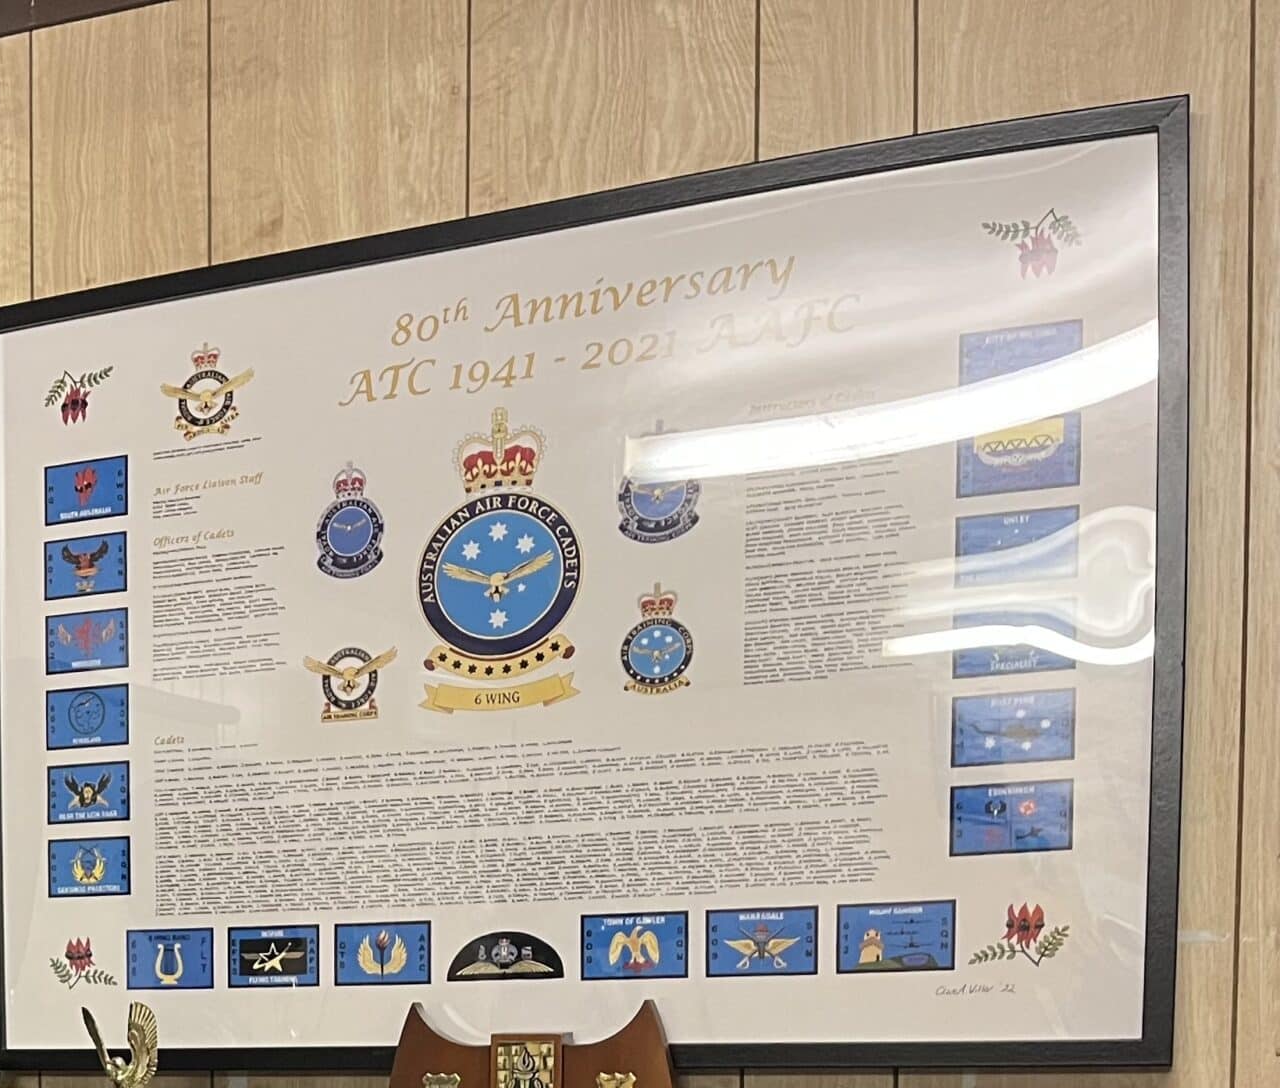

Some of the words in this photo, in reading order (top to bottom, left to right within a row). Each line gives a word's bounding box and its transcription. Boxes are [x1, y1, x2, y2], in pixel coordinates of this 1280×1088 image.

[390, 297, 470, 347] 80th
[483, 255, 795, 333] Anniversary
[338, 357, 437, 407] ATC
[448, 351, 536, 396] 1941
[581, 329, 677, 371] 2021
[697, 292, 862, 354] AAFC
[173, 482, 200, 495] Force
[153, 534, 189, 548] Officers
[203, 528, 235, 541] Cadets
[423, 510, 471, 604] AUSTRALIAN
[474, 496, 503, 515] AIR
[508, 494, 558, 526] FORCE
[555, 524, 577, 589] CADETS
[474, 693, 482, 705] 6
[485, 691, 521, 705] WING
